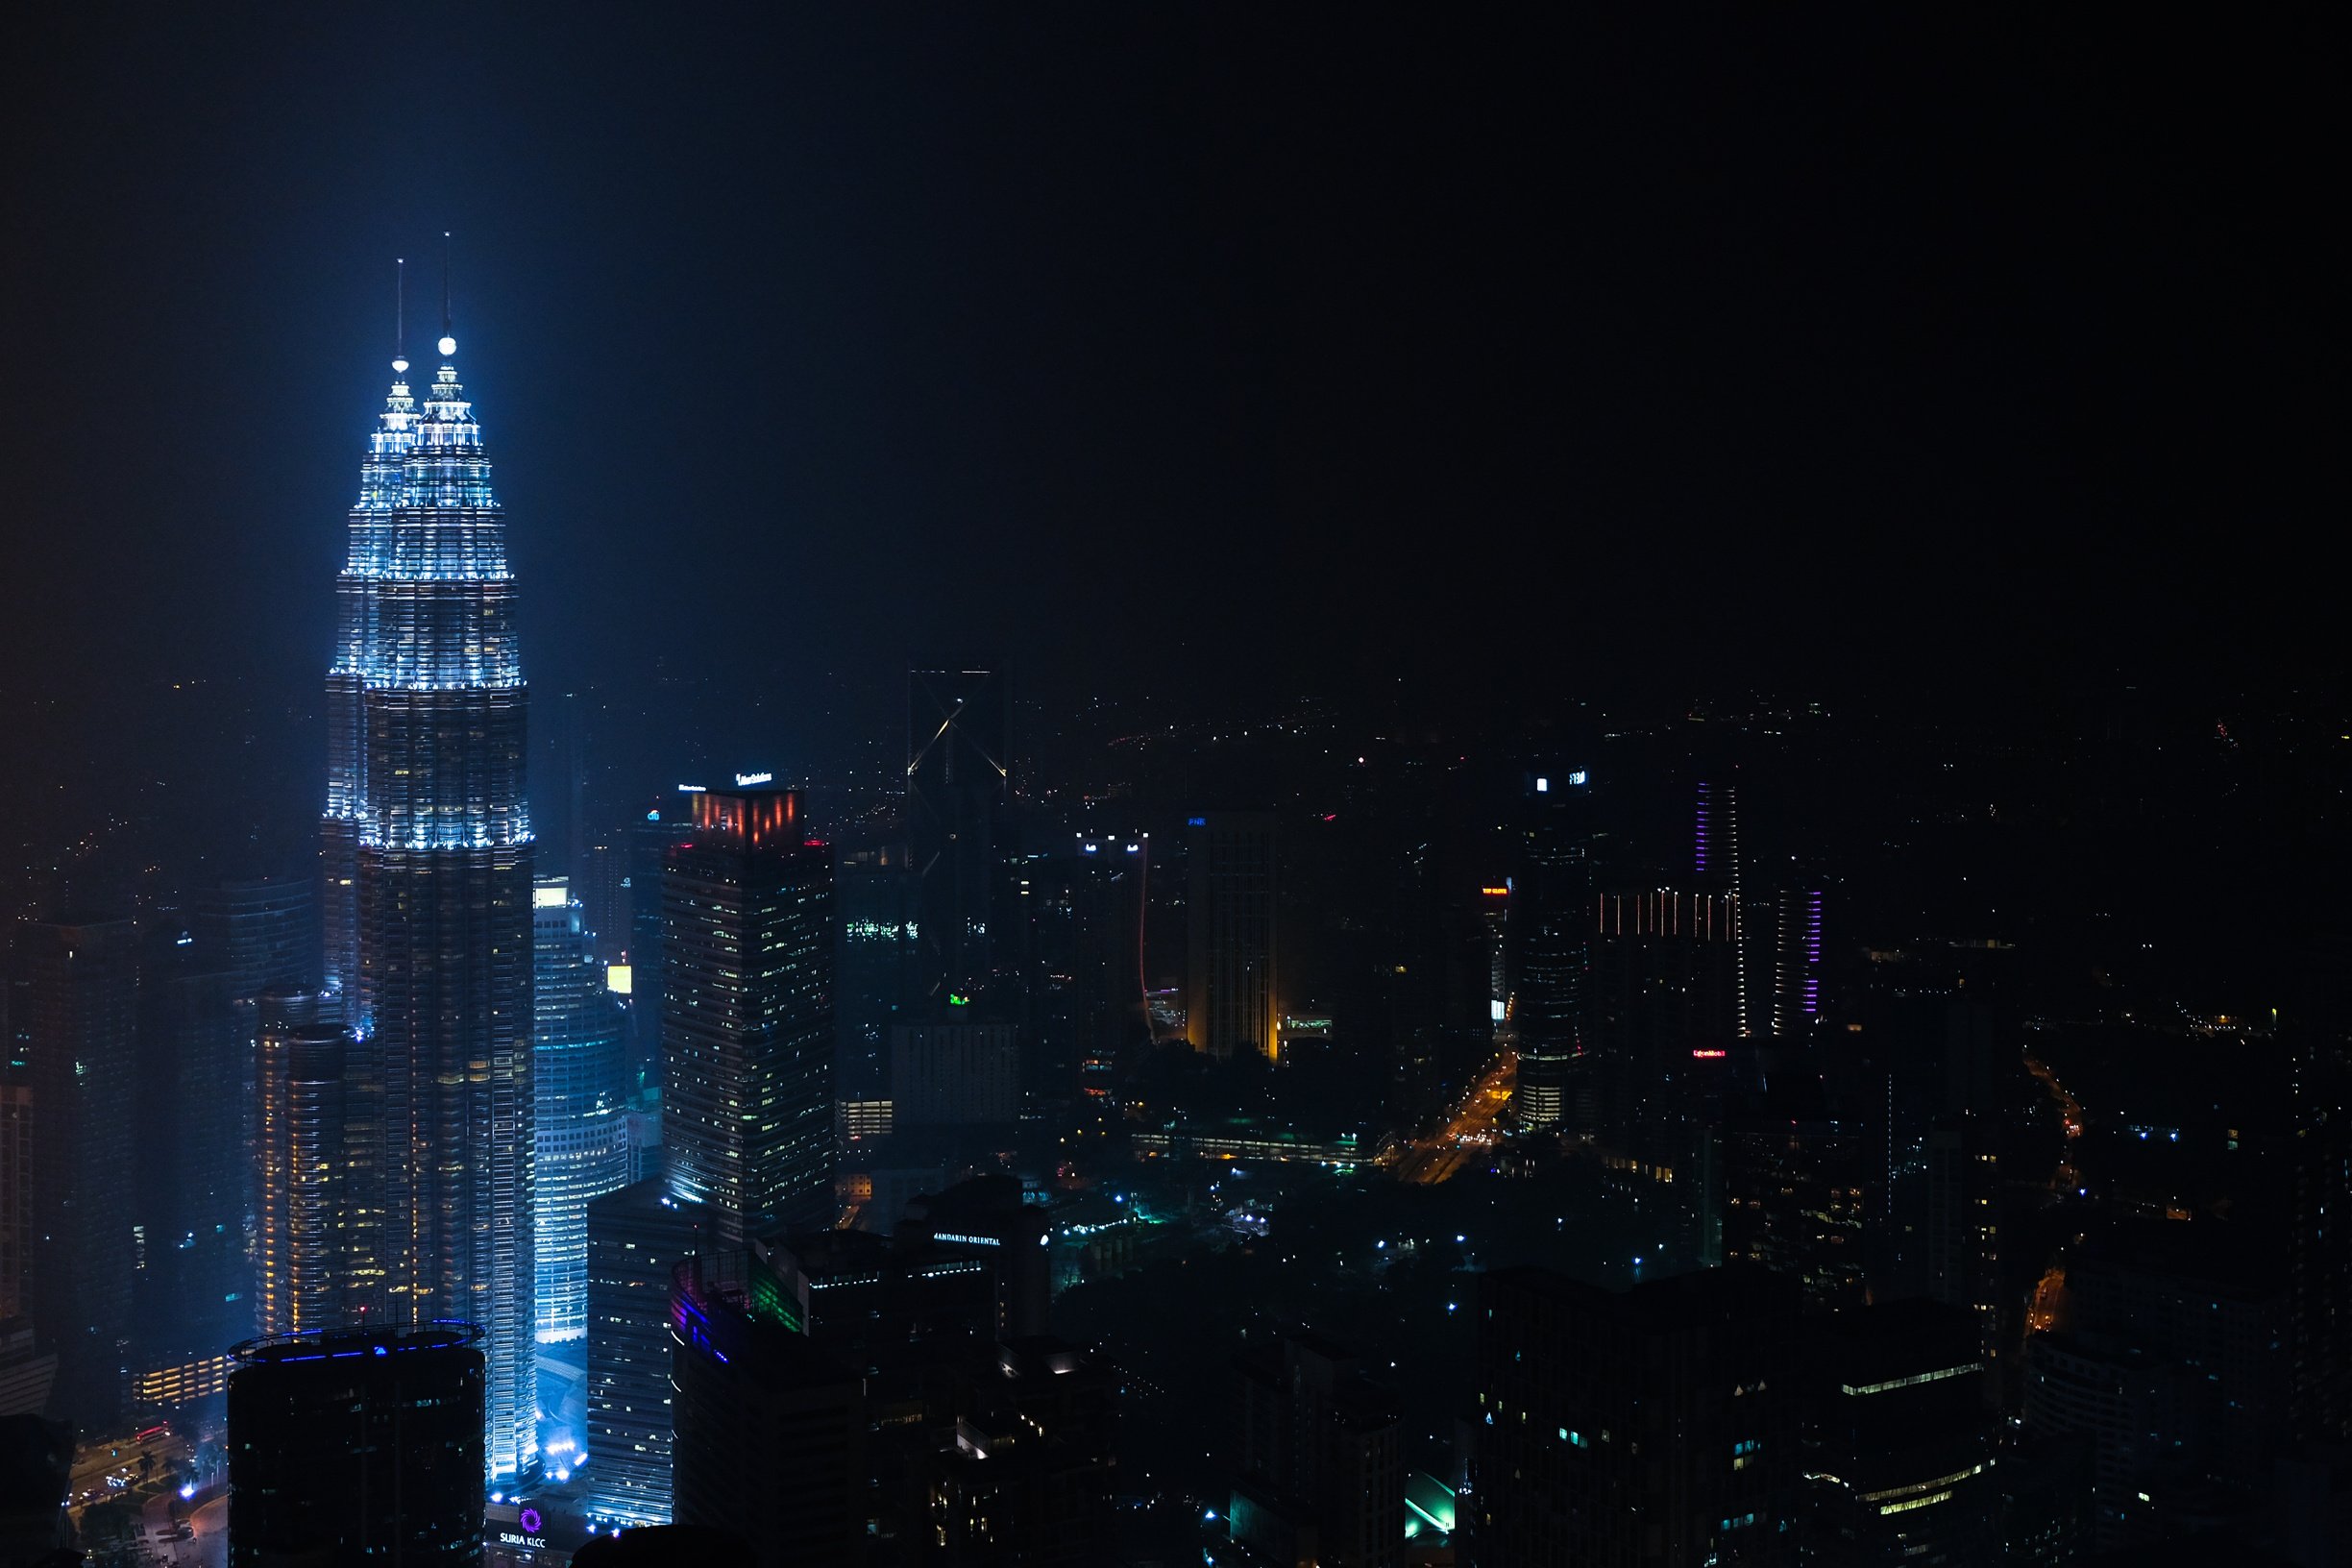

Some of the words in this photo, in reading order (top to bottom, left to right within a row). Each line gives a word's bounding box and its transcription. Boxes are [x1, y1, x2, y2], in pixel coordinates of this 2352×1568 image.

[968, 1236, 1000, 1246] ORIENTAL
[500, 1532, 526, 1545] SURIA
[527, 1536, 546, 1549] KLCC
